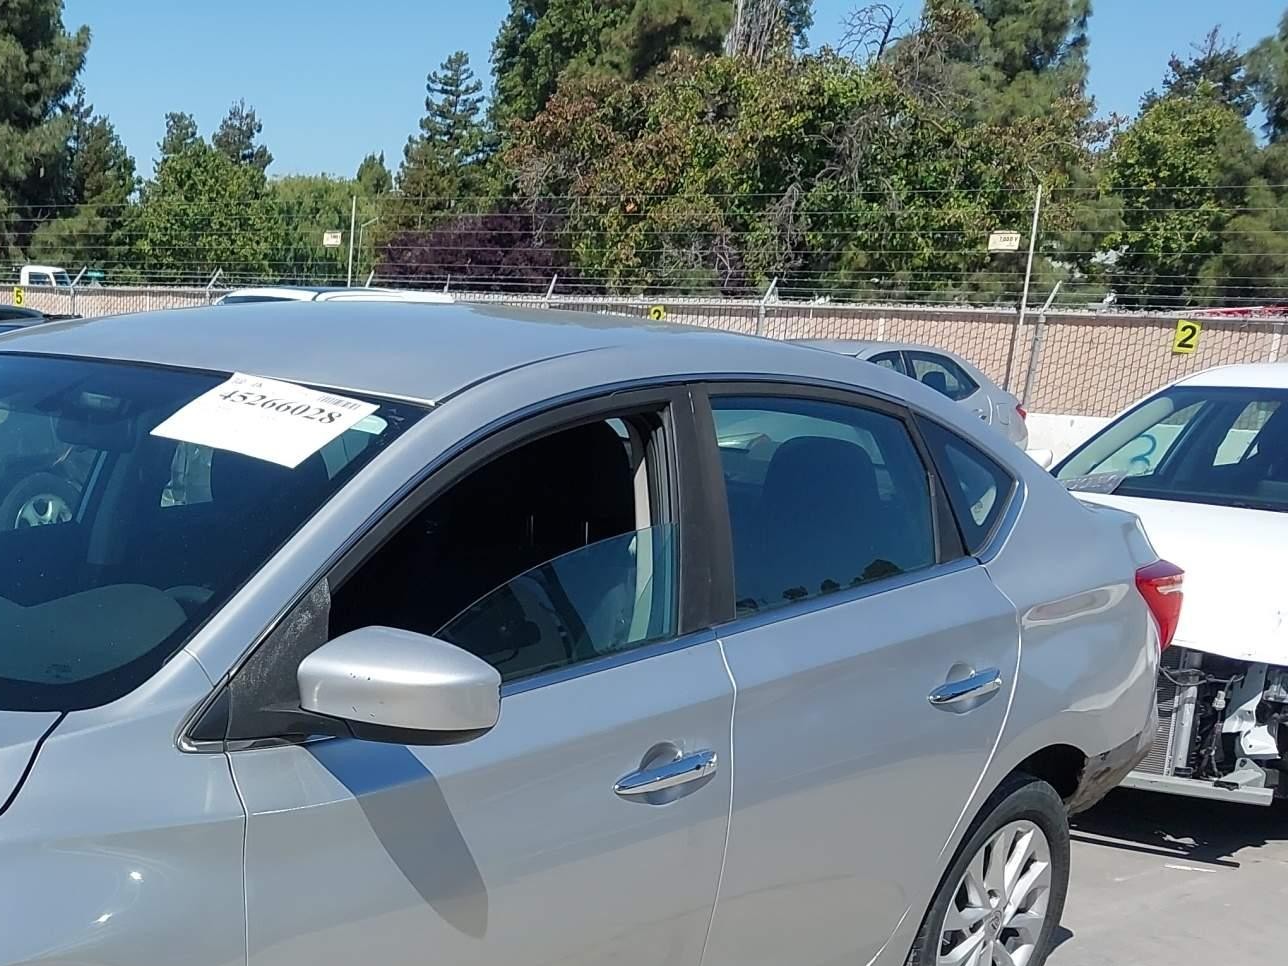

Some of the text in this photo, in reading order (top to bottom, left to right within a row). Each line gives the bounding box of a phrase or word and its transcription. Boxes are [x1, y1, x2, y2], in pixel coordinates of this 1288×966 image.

[16, 290, 23, 304] 5
[1177, 325, 1197, 349] 2
[219, 390, 342, 424] 45266028
